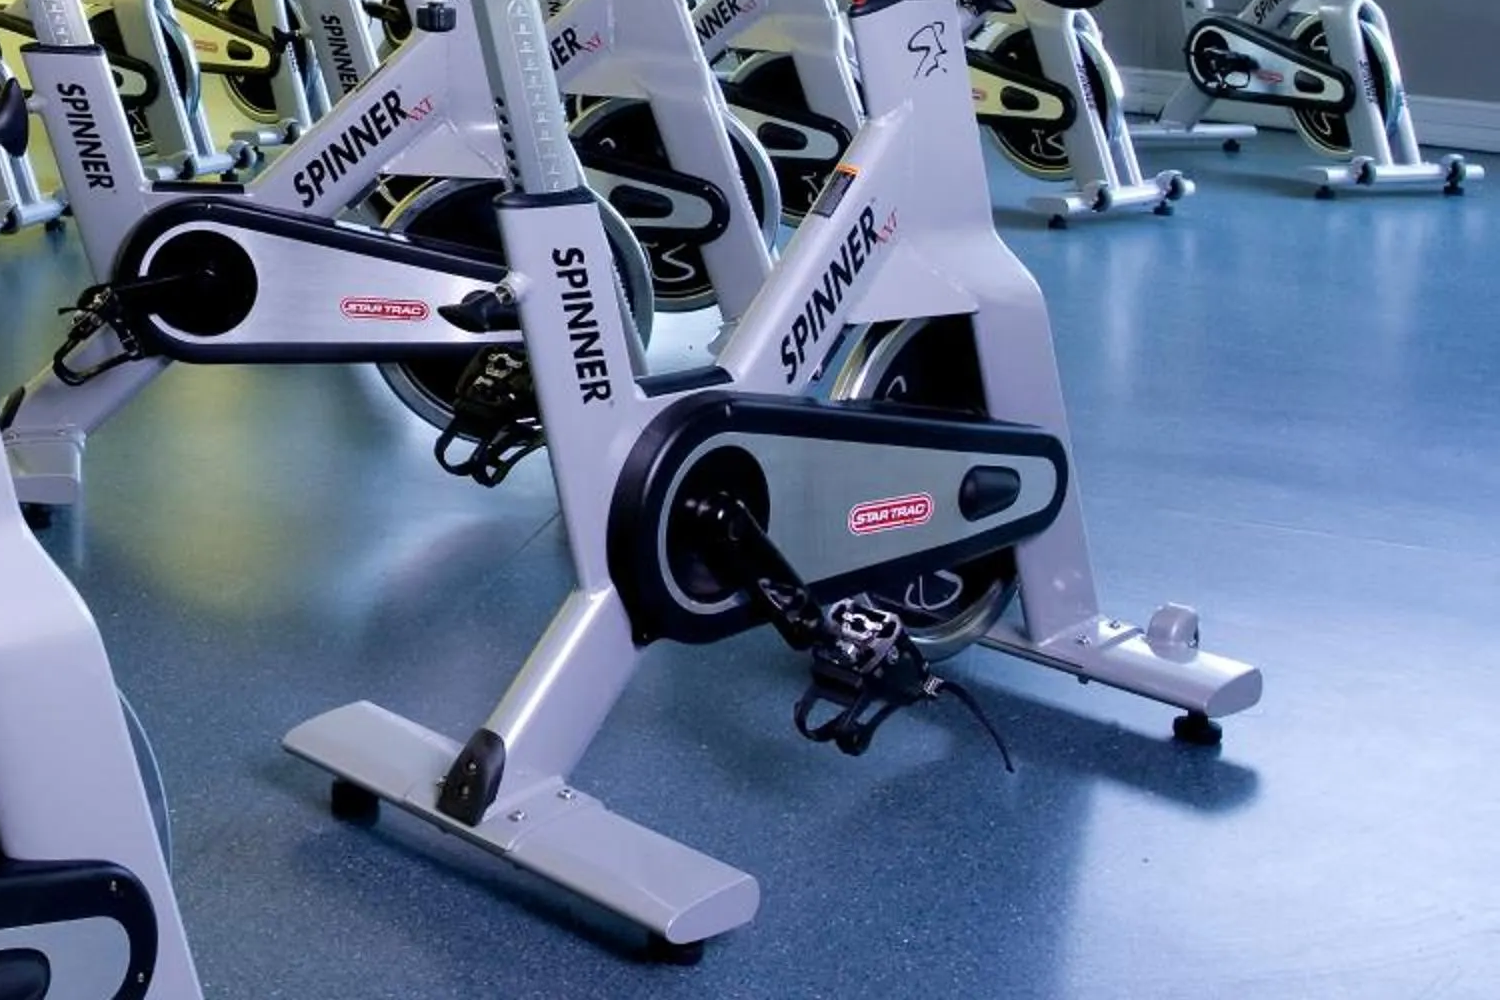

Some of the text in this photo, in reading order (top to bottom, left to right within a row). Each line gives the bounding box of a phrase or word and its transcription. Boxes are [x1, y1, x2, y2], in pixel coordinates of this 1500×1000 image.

[57, 83, 114, 189] SPINNER
[294, 89, 408, 208] SPINNER
[384, 305, 422, 315] TRAC
[552, 247, 612, 405] SPINNER
[780, 205, 878, 385] SPINNER
[856, 503, 926, 525] STAR TRAC
